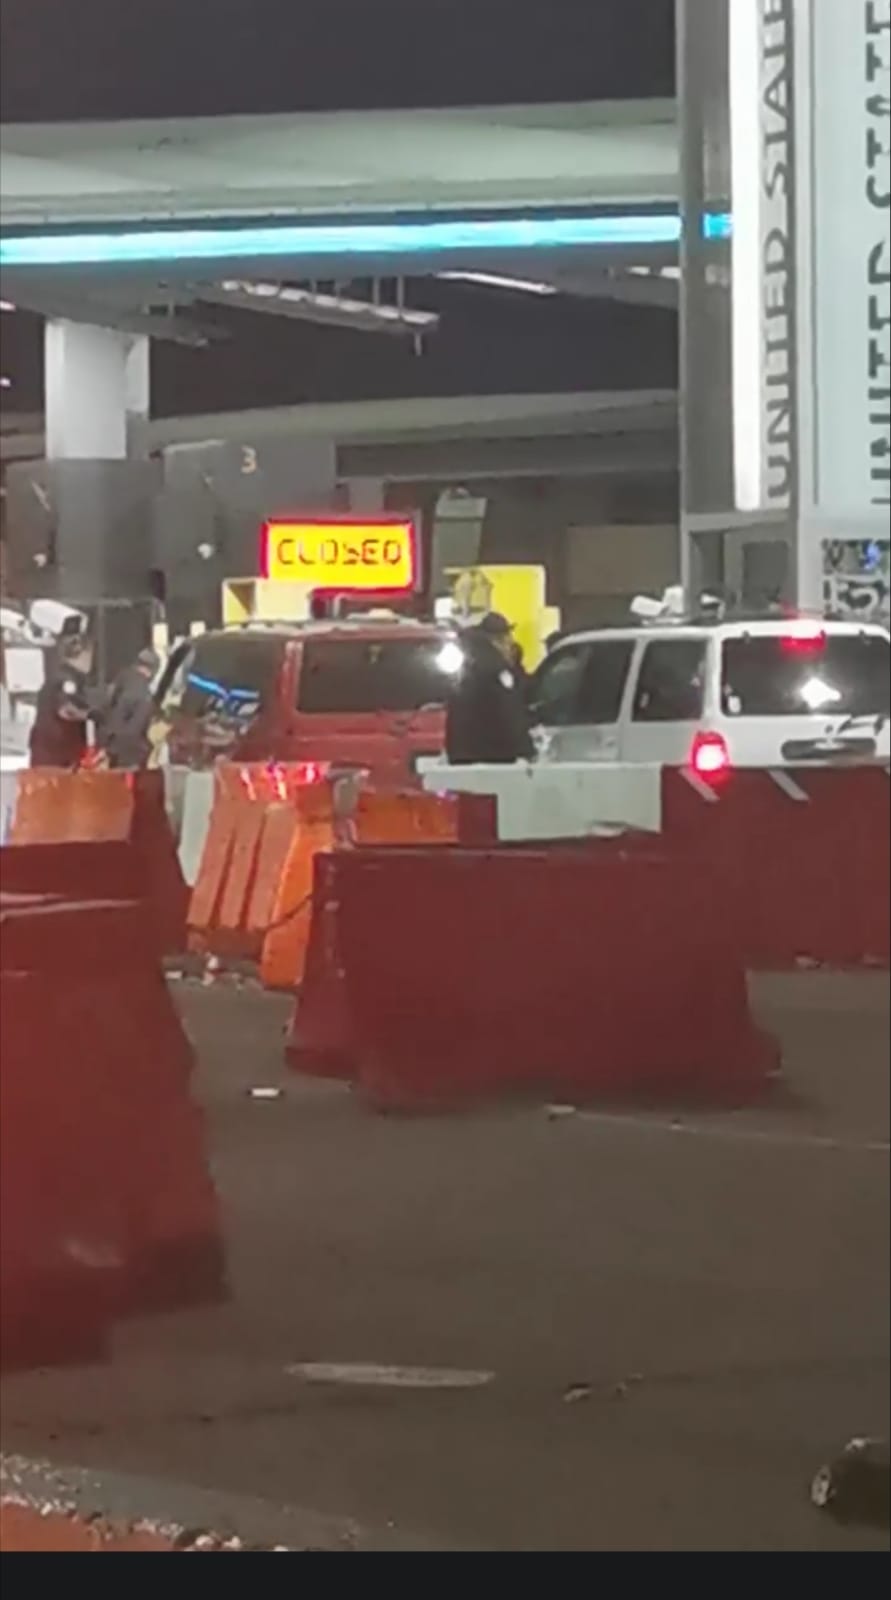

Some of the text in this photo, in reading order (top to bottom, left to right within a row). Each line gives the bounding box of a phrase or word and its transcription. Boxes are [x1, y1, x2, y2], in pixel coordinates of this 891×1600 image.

[763, 226, 790, 499] UNITED
[240, 446, 257, 474] 3
[277, 538, 403, 566] CLOSED
